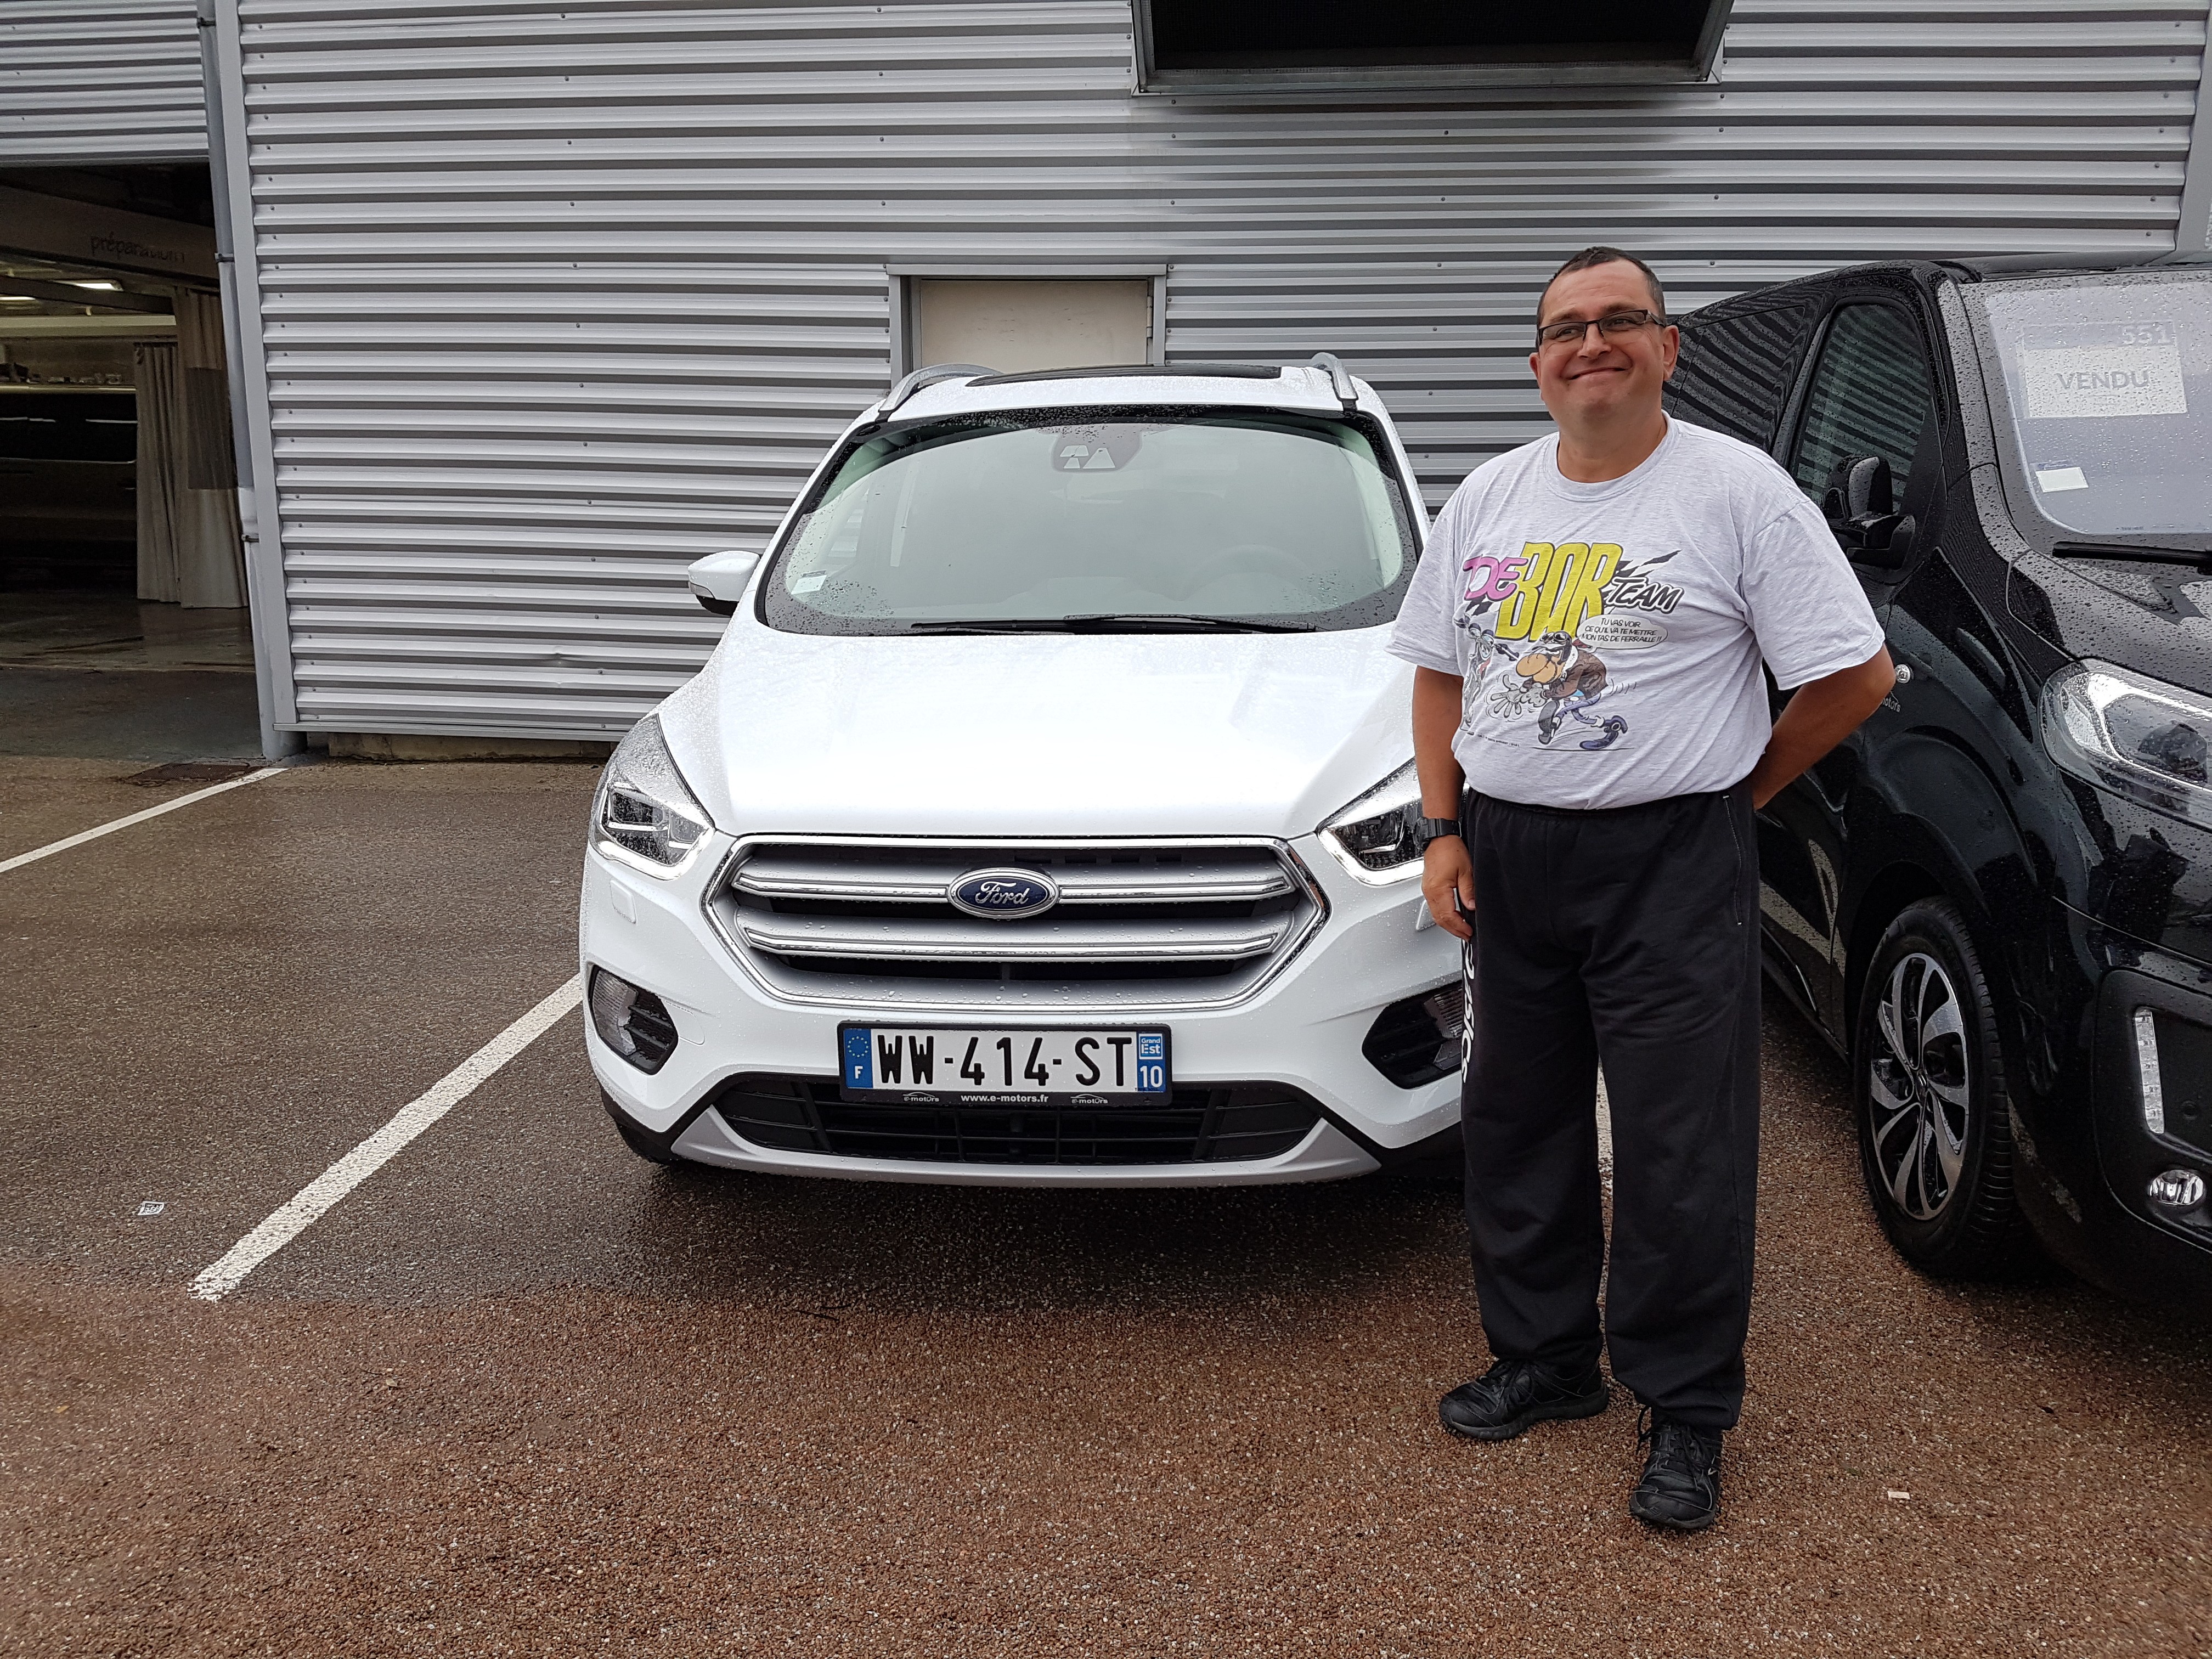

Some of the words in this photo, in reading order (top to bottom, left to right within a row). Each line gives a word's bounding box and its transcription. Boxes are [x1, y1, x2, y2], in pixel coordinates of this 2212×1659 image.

[2056, 370, 2149, 390] VENDU
[1607, 578, 1683, 613] TEAM
[975, 881, 1030, 905] Ford
[1141, 1043, 1160, 1054] Est
[877, 1035, 1132, 1086] WW-414-ST
[854, 1065, 863, 1079] F
[1140, 1065, 1163, 1087] 10
[961, 1094, 1049, 1103] www.e-motors.fr
